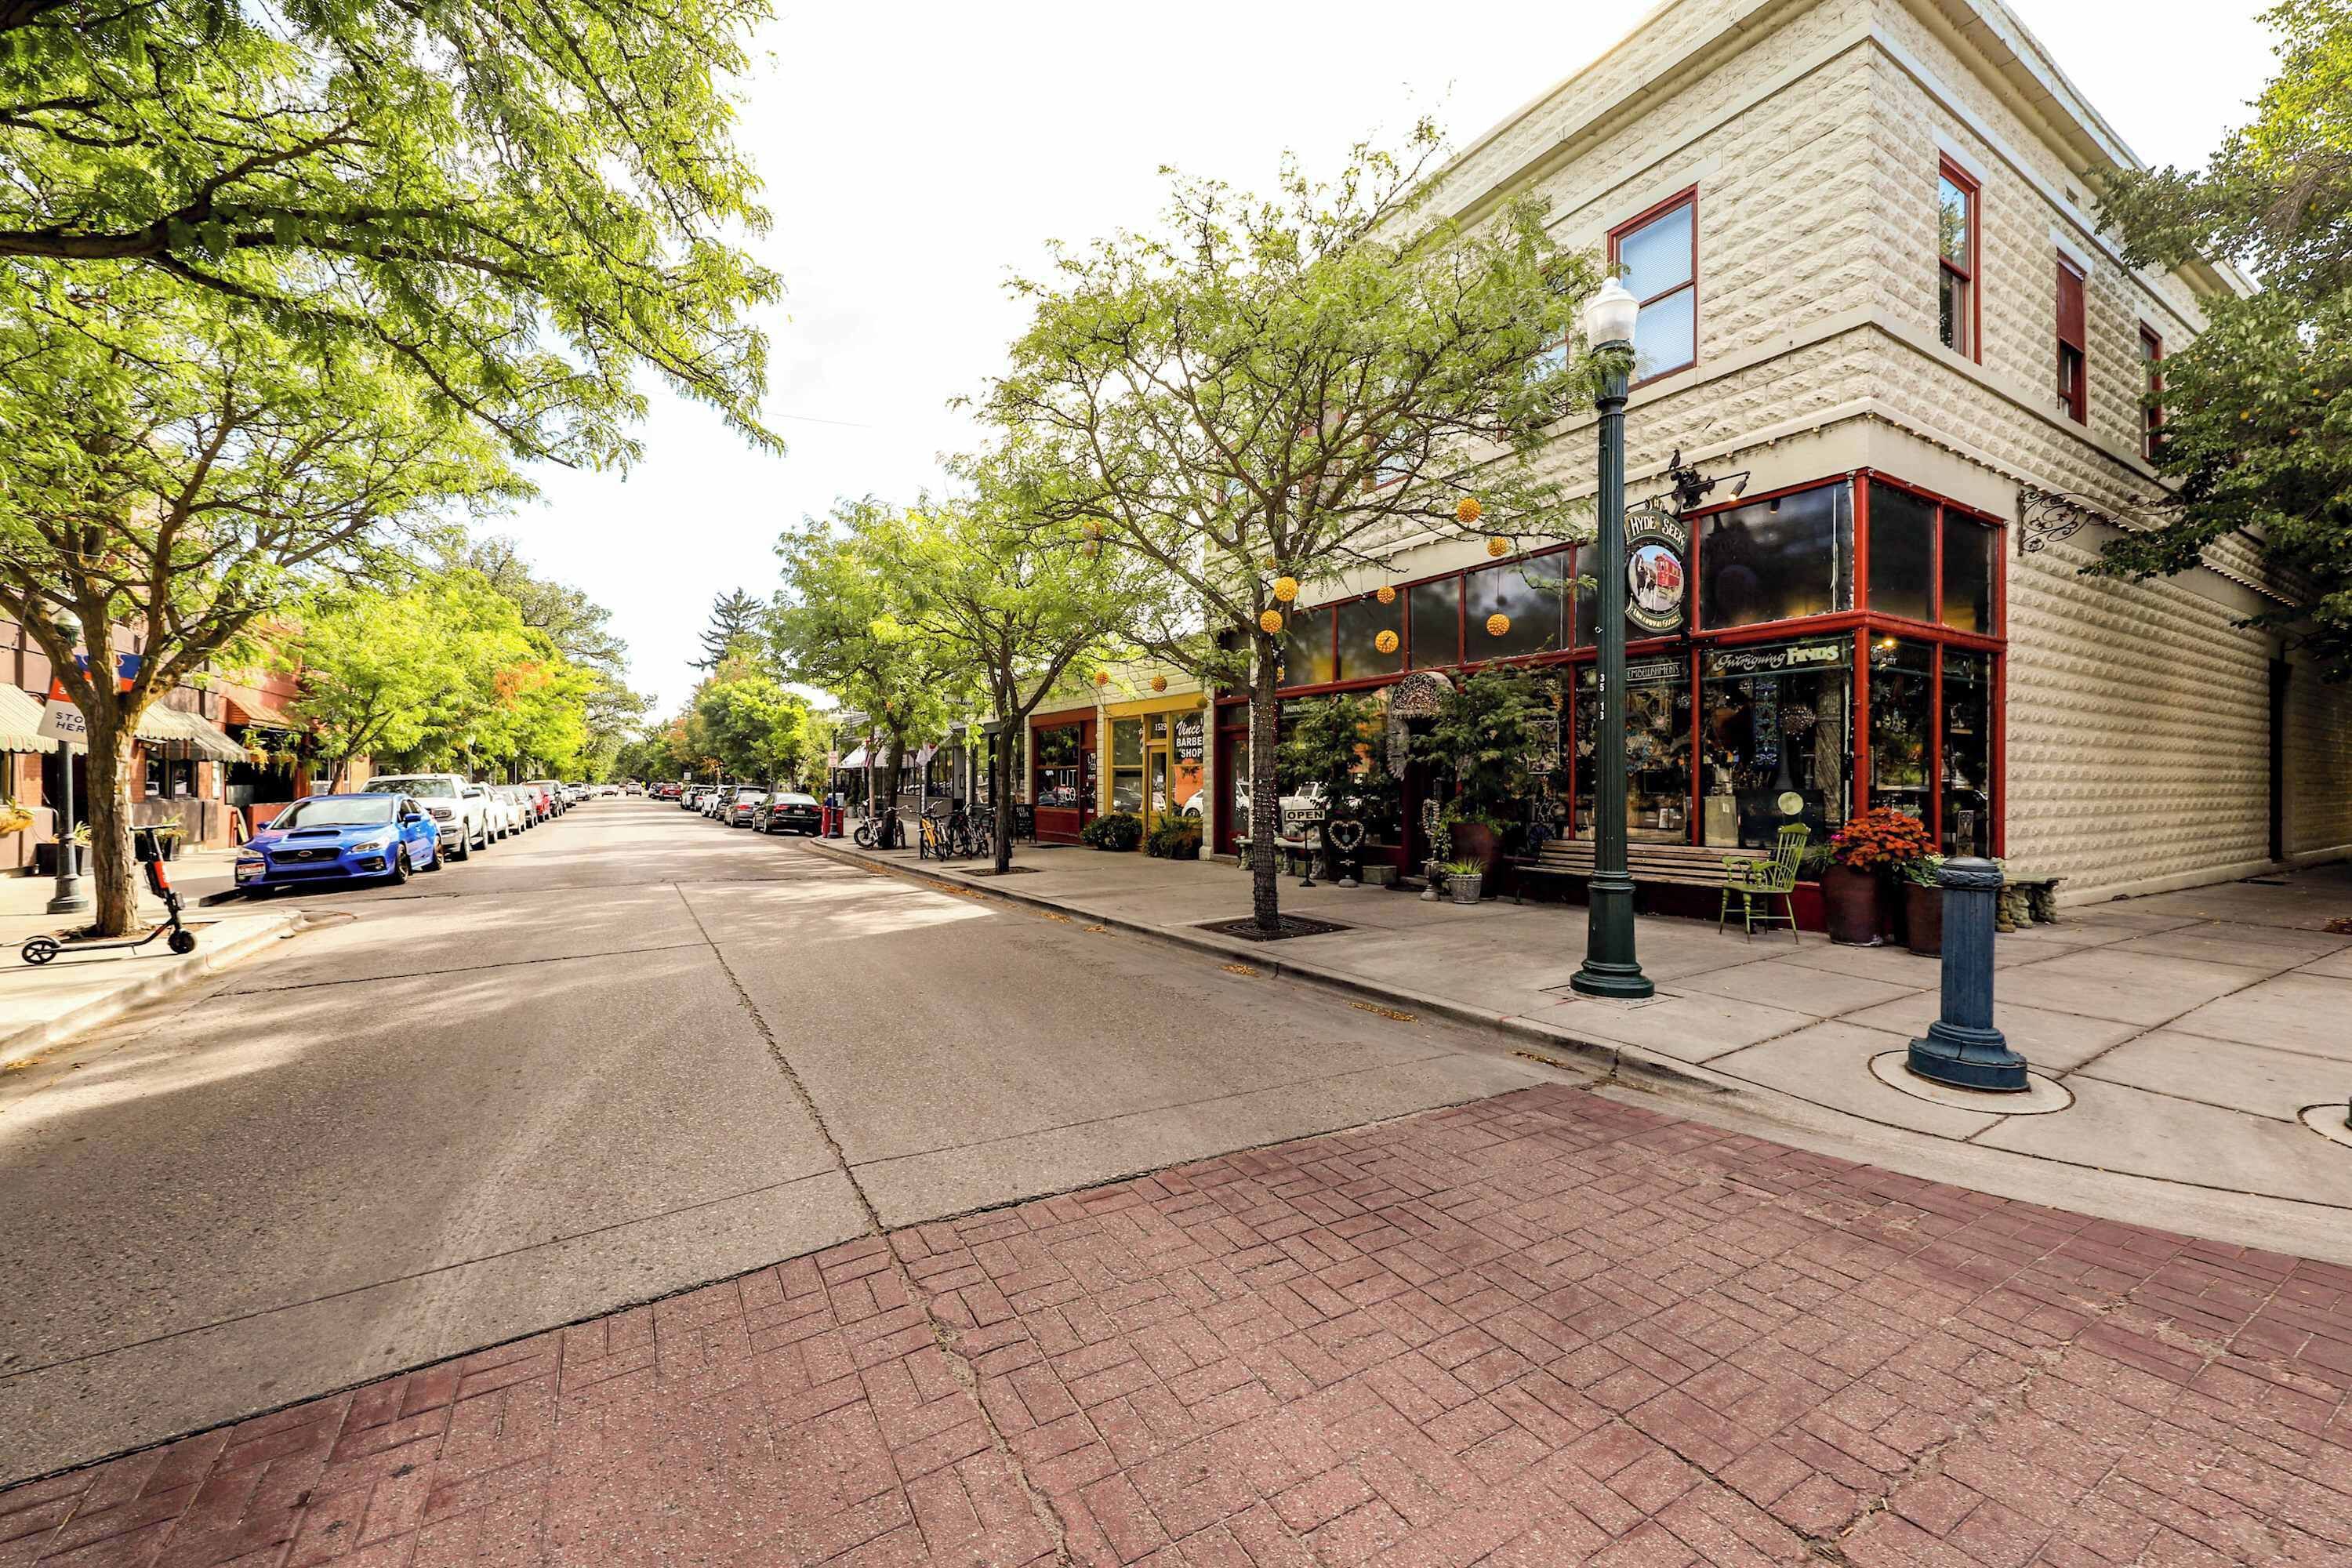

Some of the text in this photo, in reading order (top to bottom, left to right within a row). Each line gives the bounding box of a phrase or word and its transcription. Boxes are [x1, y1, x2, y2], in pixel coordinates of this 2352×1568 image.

[1631, 516, 1686, 546] HYDE SEEK
[1712, 645, 1839, 672] Intriguing FINDS
[1627, 665, 1680, 679] EMBELLISHMENTS
[56, 711, 84, 723] STO
[56, 721, 85, 733] HER
[1176, 736, 1204, 747] BARBE
[1060, 769, 1077, 786] LIT
[1287, 811, 1323, 819] OPEN
